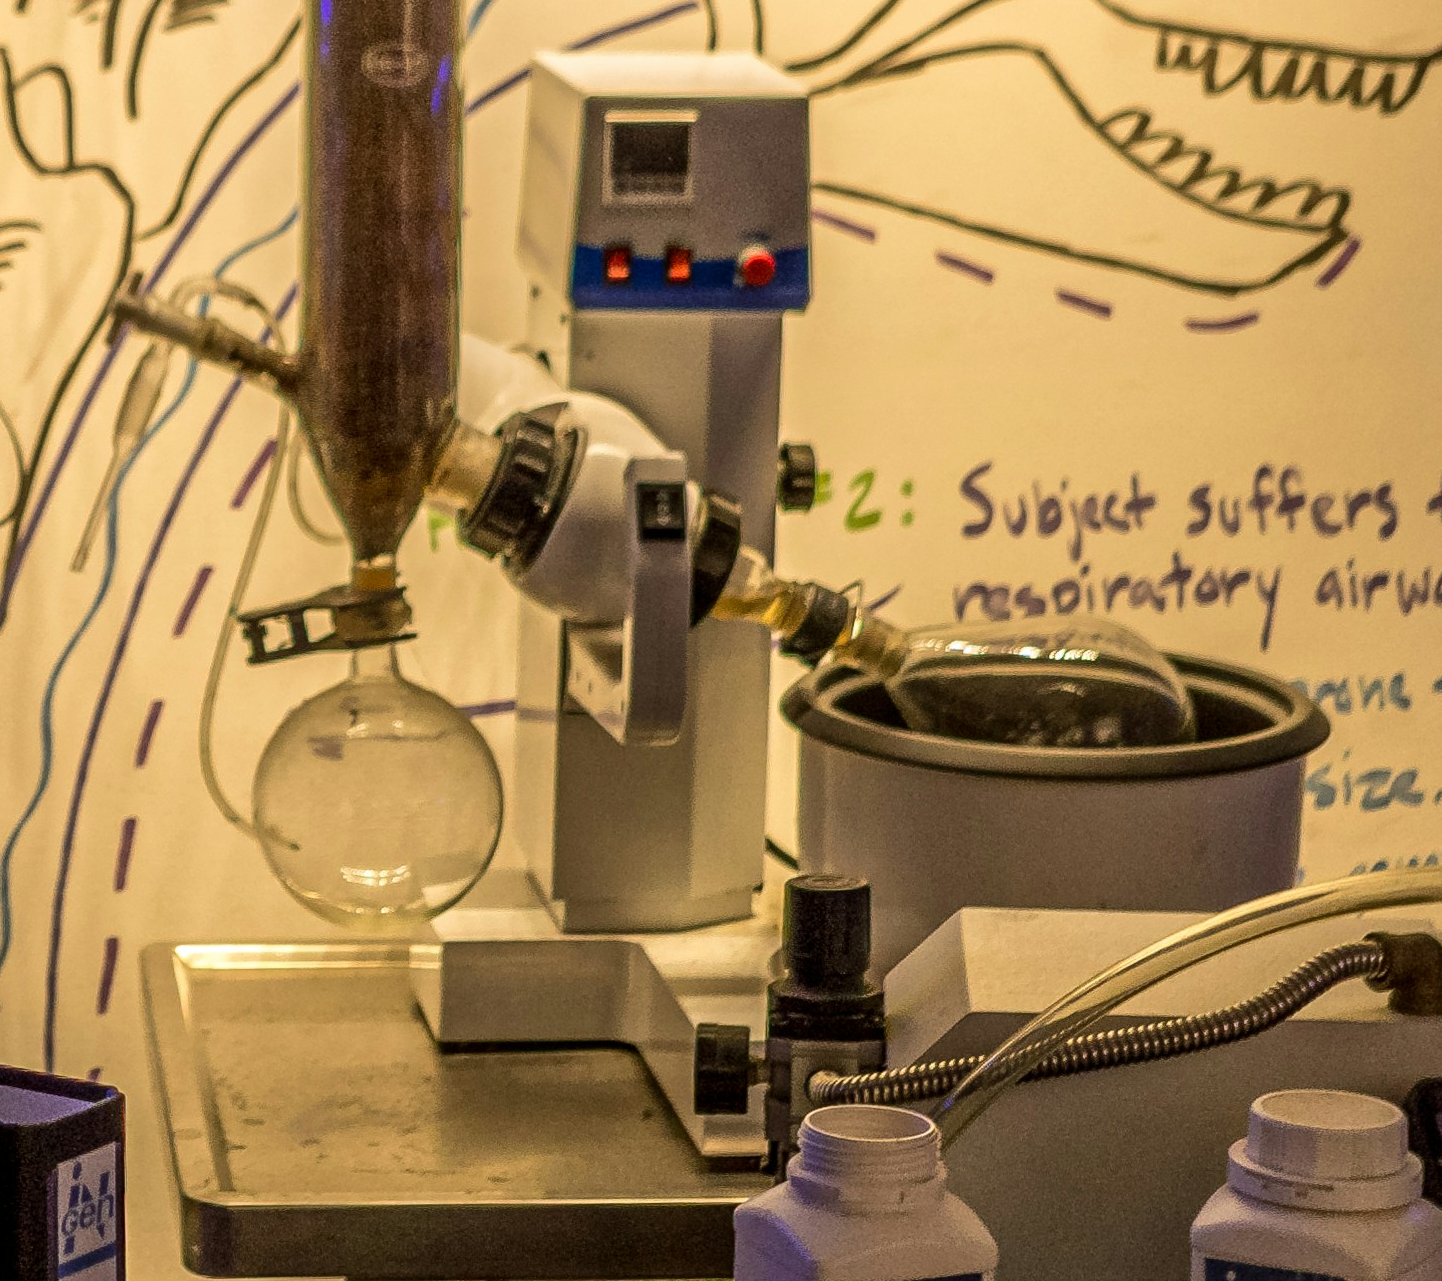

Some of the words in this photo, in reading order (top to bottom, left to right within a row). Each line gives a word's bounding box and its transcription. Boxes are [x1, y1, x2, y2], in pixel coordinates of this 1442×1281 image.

[959, 458, 1158, 564] Subject
[1186, 463, 1400, 540] suffers
[952, 550, 1283, 654] respiratory
